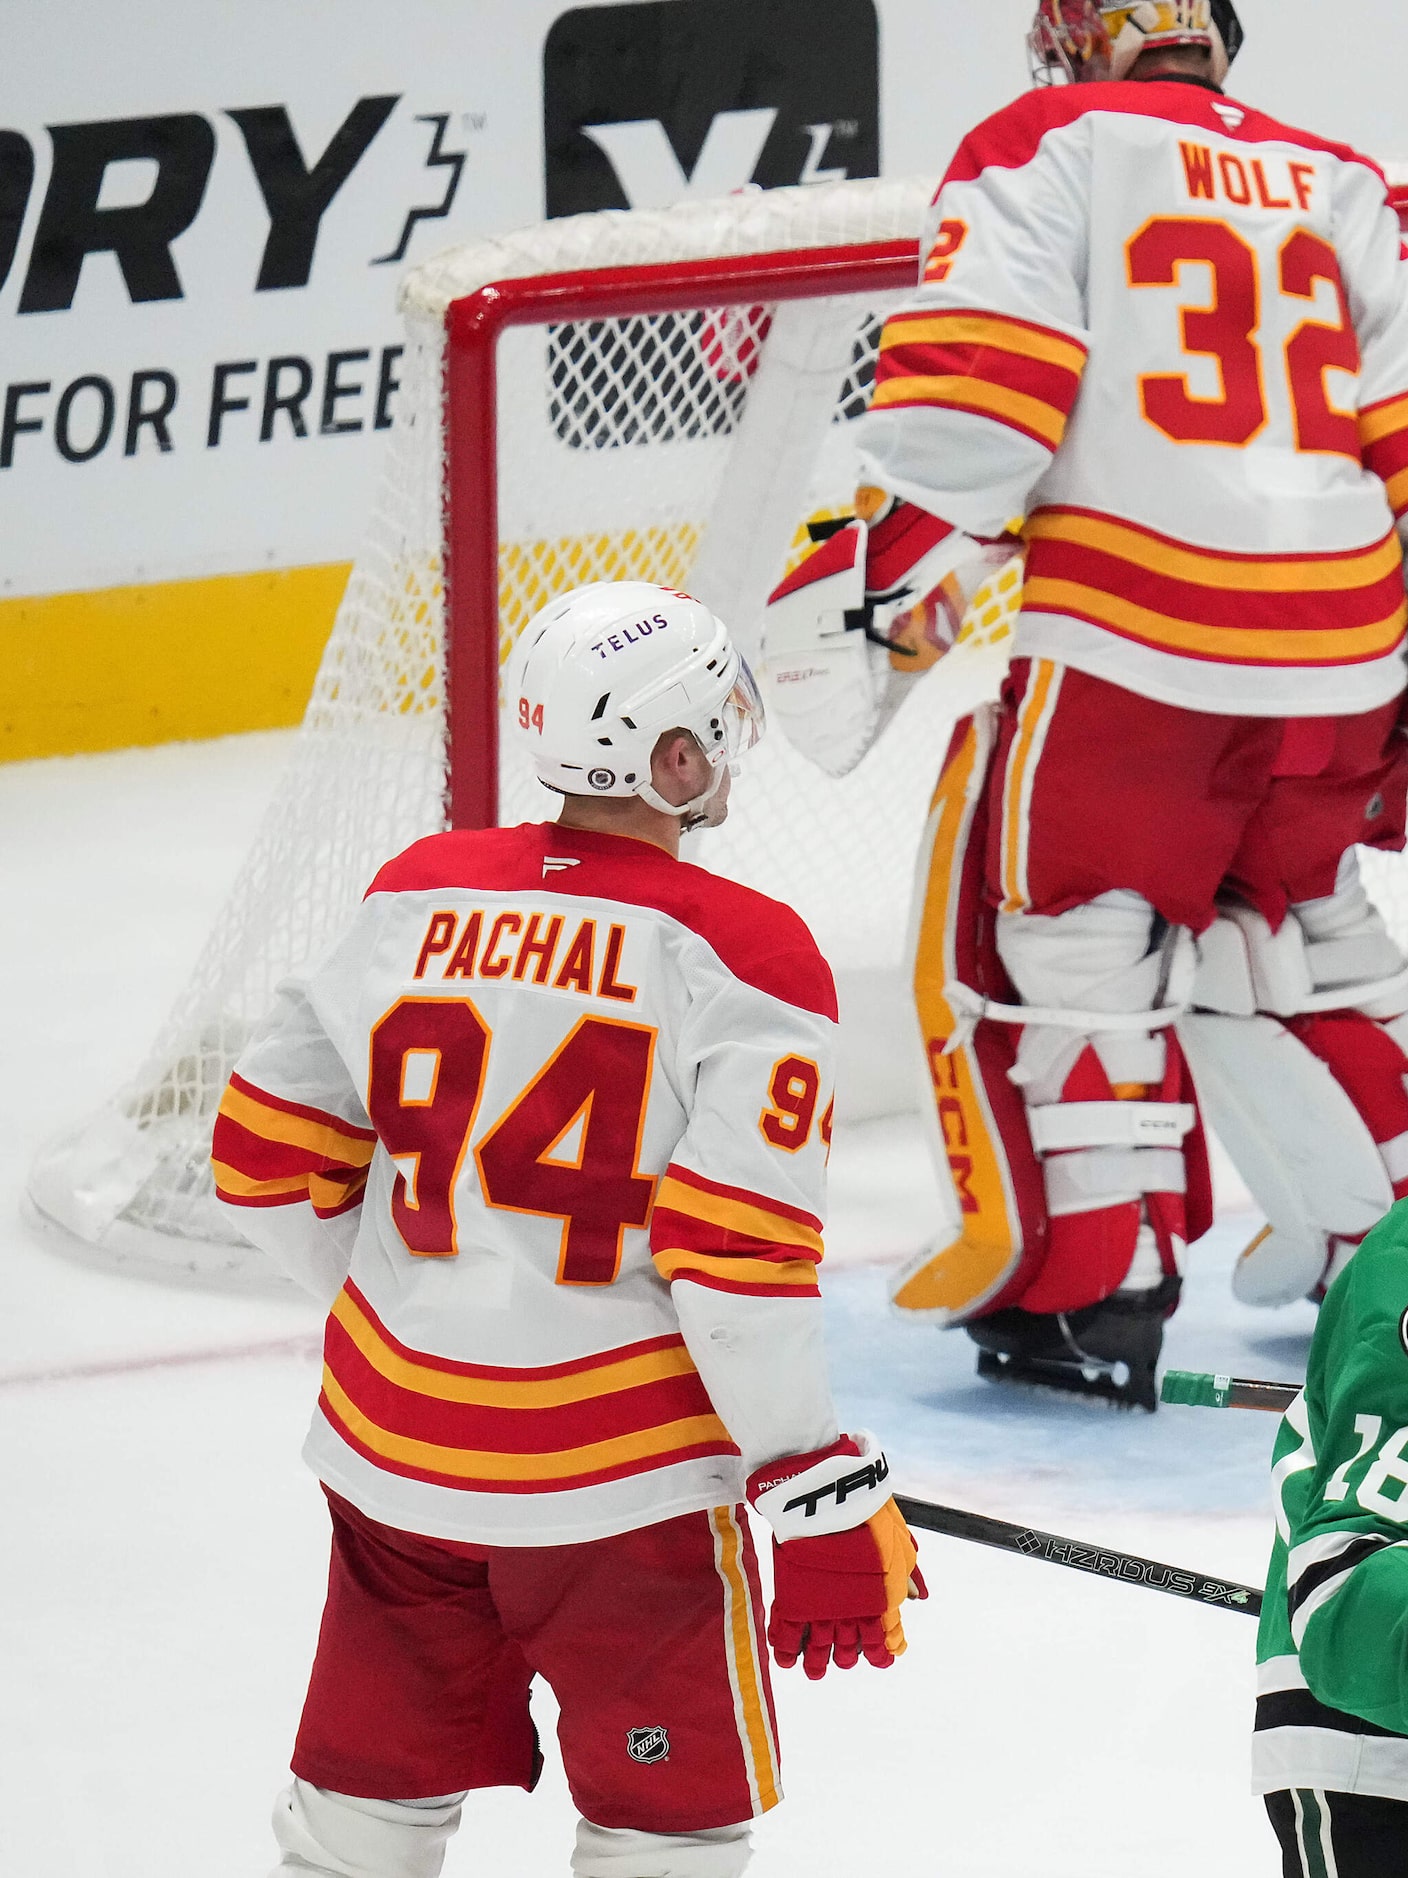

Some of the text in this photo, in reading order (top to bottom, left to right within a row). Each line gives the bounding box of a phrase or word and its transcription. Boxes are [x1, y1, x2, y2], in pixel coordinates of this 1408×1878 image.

[1178, 140, 1316, 211] WOLF
[1124, 213, 1362, 467] 32
[0, 373, 178, 469] FOR
[591, 614, 668, 659] TELUS
[518, 697, 544, 736] 94
[412, 910, 638, 1003] PACHAL
[366, 995, 660, 1287] 94
[758, 1052, 834, 1168] 9
[928, 1037, 980, 1213] CCM
[1044, 1538, 1196, 1595] HZRDUS
[637, 1734, 660, 1756] NHL
